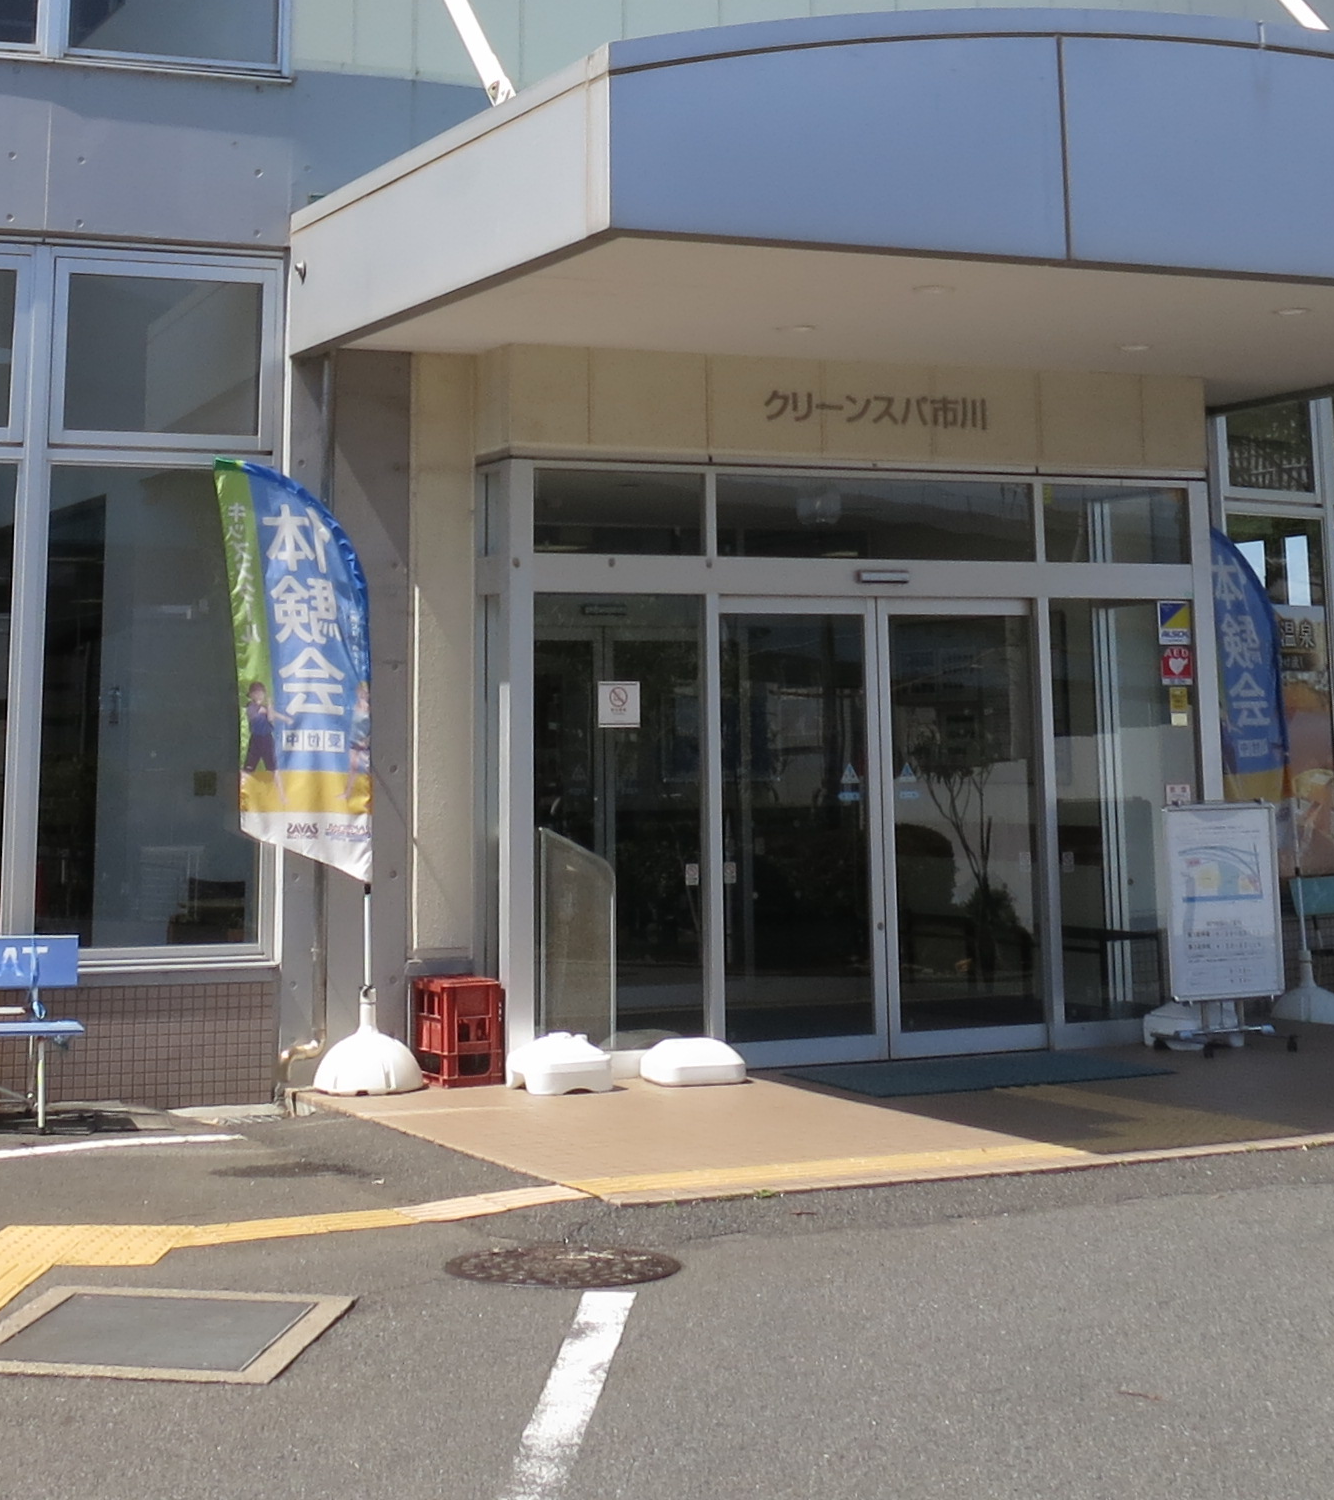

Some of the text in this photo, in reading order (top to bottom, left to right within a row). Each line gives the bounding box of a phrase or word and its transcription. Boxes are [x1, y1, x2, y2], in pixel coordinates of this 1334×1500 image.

[764, 390, 988, 430] クリーンスパ市川
[1163, 648, 1189, 659] AED
